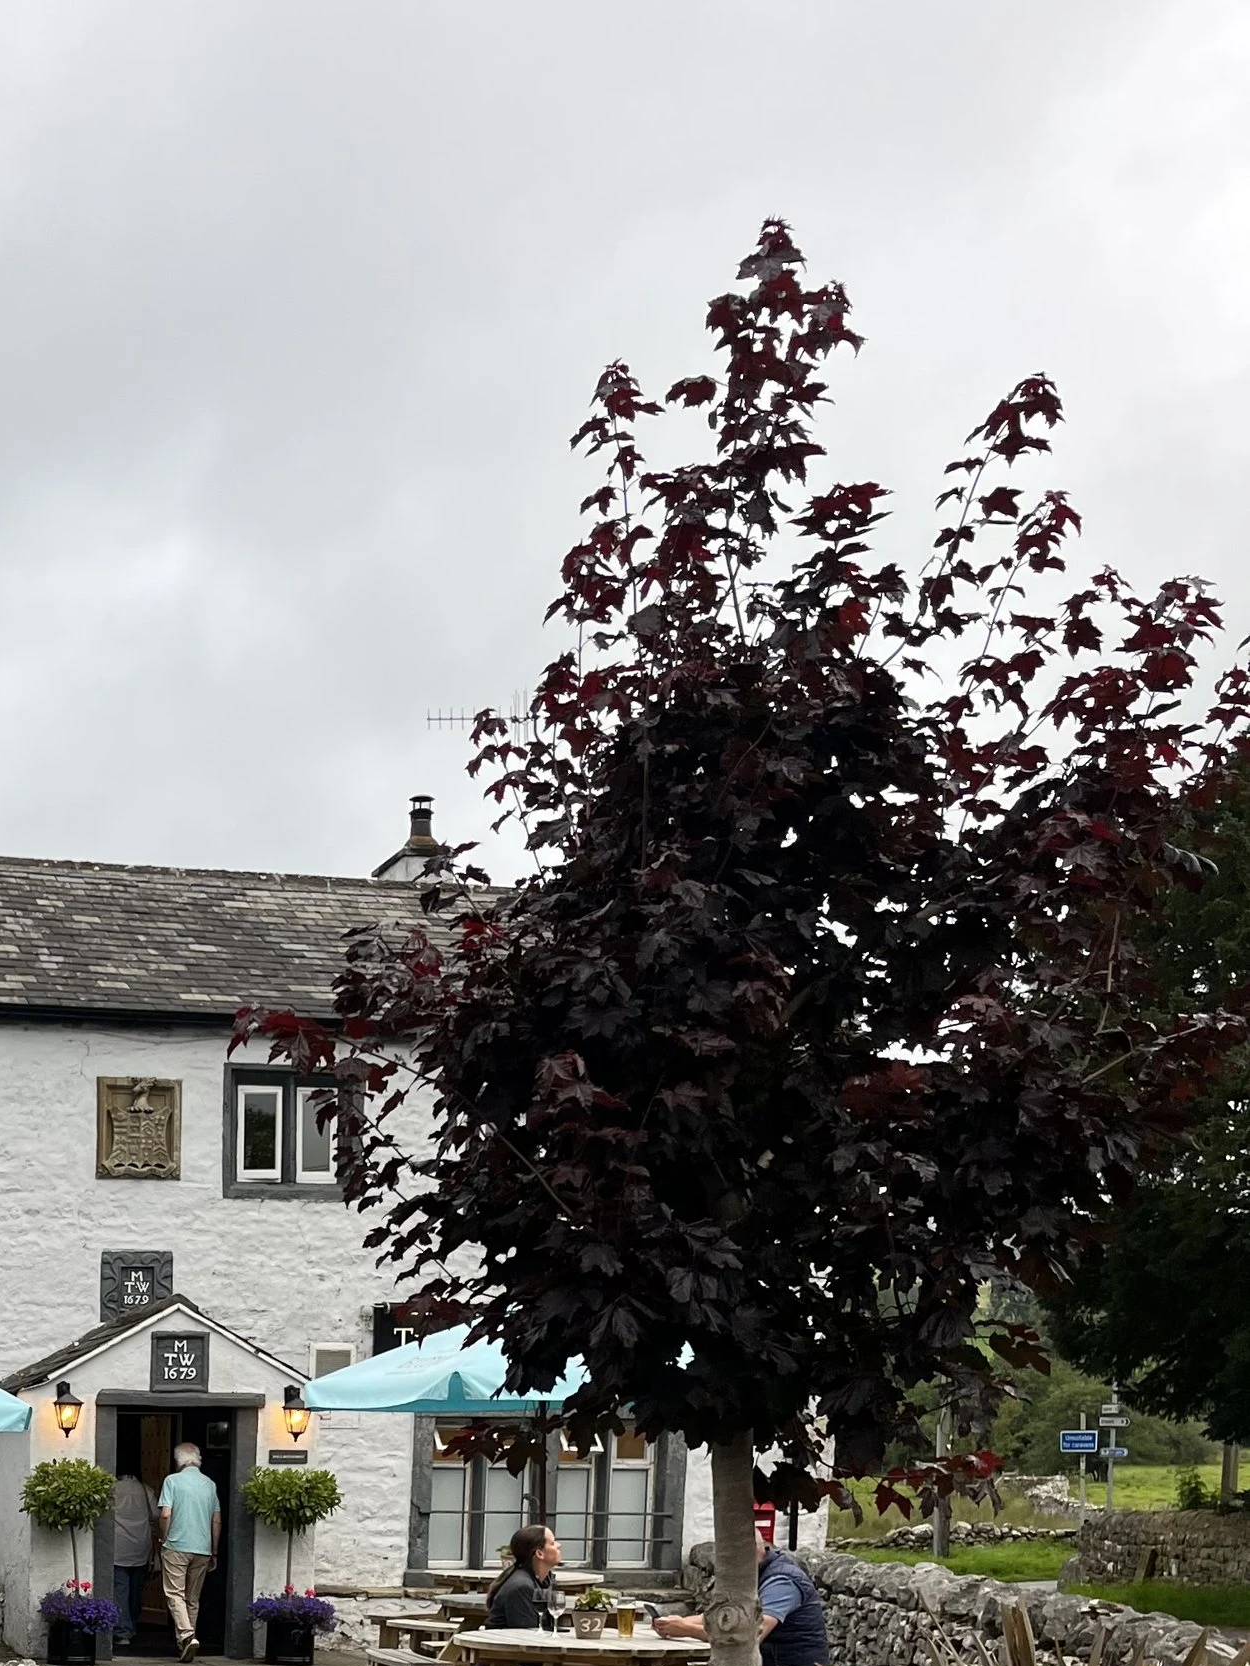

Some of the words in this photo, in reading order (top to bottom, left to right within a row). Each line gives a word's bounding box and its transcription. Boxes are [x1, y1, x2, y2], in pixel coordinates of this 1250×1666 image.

[131, 1271, 144, 1281] M
[124, 1295, 150, 1305] 1679
[174, 1340, 188, 1353] M
[164, 1367, 197, 1380] 1679
[580, 1618, 601, 1632] 32
